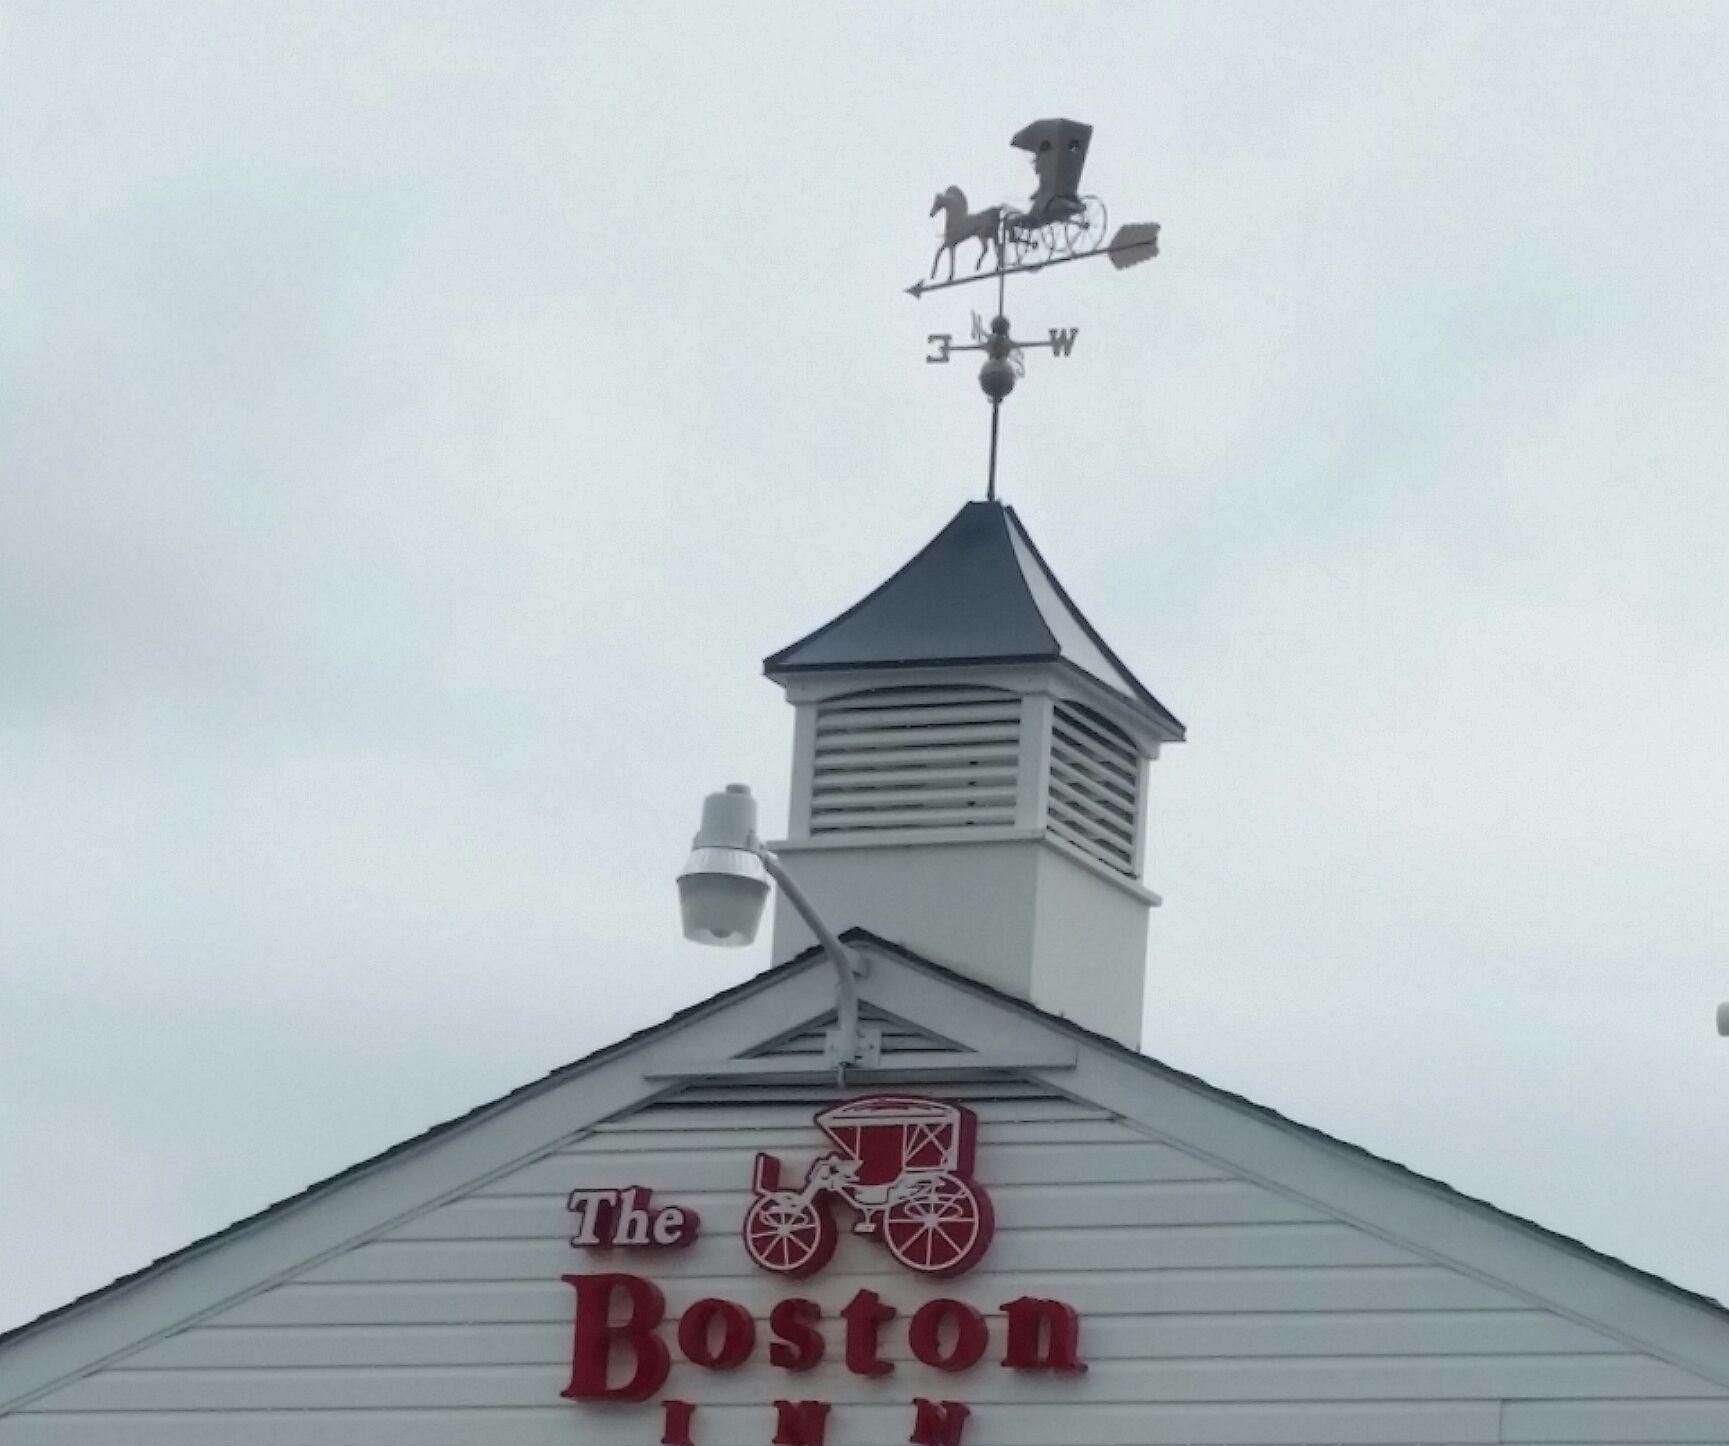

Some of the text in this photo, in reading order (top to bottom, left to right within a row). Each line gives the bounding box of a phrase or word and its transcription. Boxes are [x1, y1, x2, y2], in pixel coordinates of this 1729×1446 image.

[1048, 327, 1079, 357] W
[567, 1186, 699, 1250] The
[560, 1272, 1088, 1402] Boston
